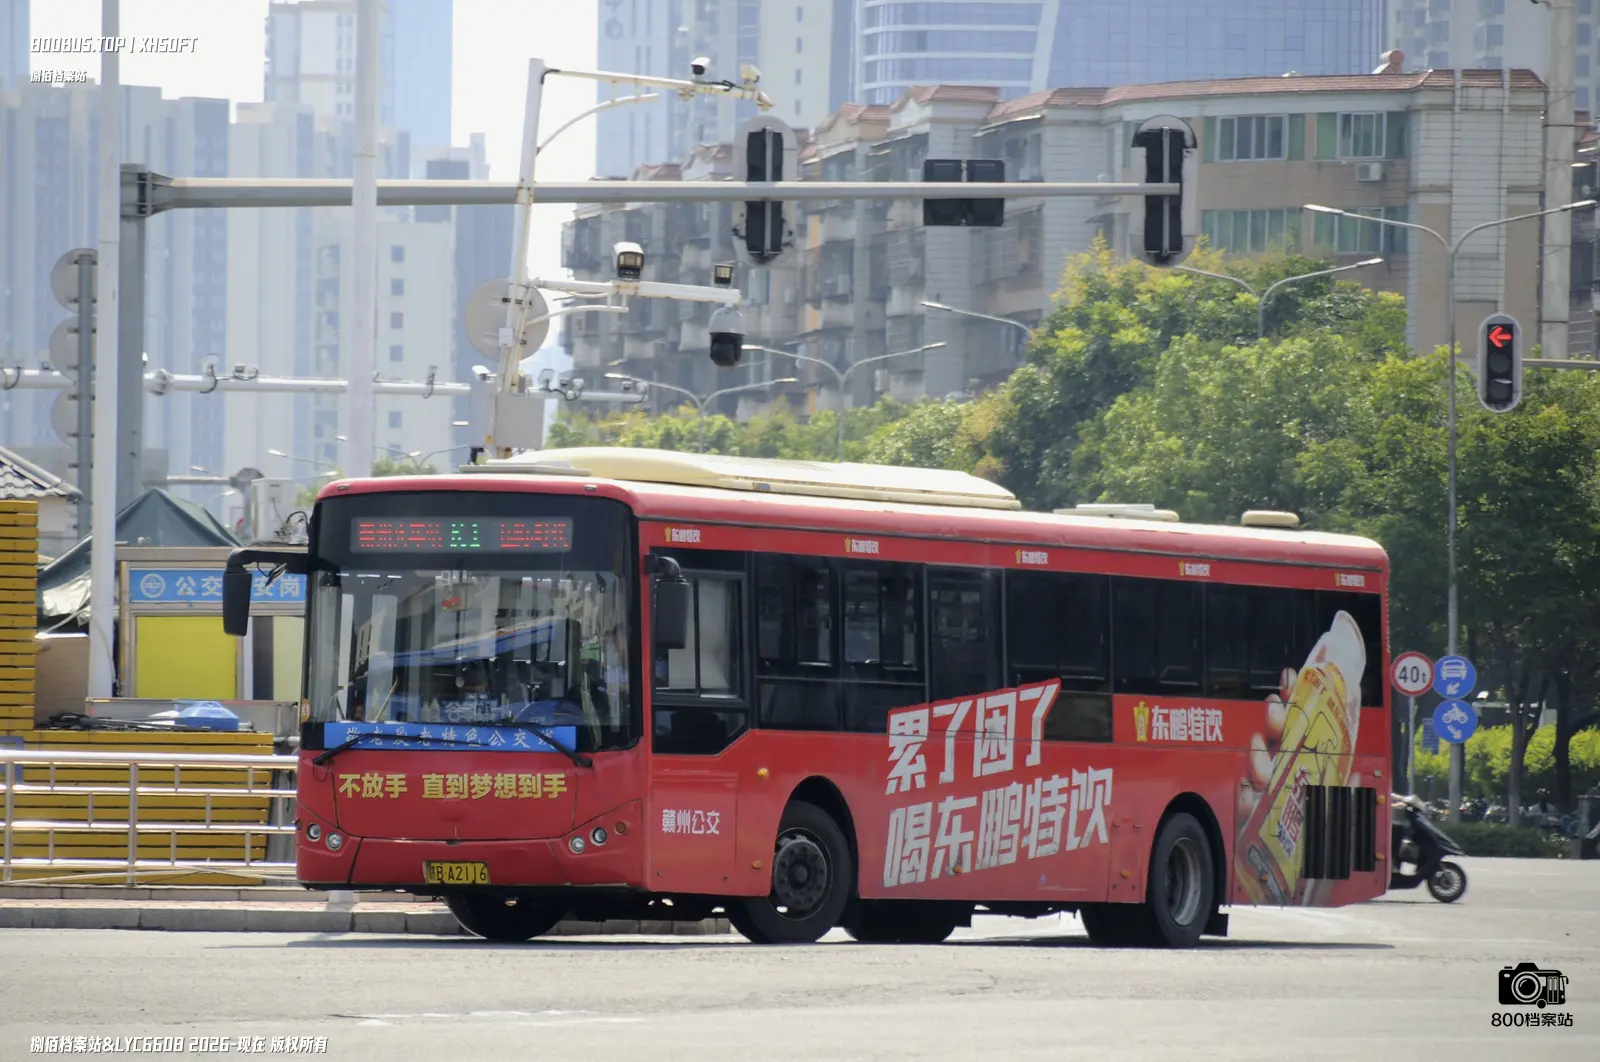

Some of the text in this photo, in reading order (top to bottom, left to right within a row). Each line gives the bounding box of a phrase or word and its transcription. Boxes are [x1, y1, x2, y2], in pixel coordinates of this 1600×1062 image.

[175, 576, 301, 597] 公交安岗
[1151, 705, 1224, 742] 东鹏特饮
[885, 684, 1060, 795] 累了困了
[339, 774, 568, 799] 不放手 直到梦想到手
[662, 808, 720, 834] 赣州公交
[883, 766, 1113, 888] 喝东鹏特饮
